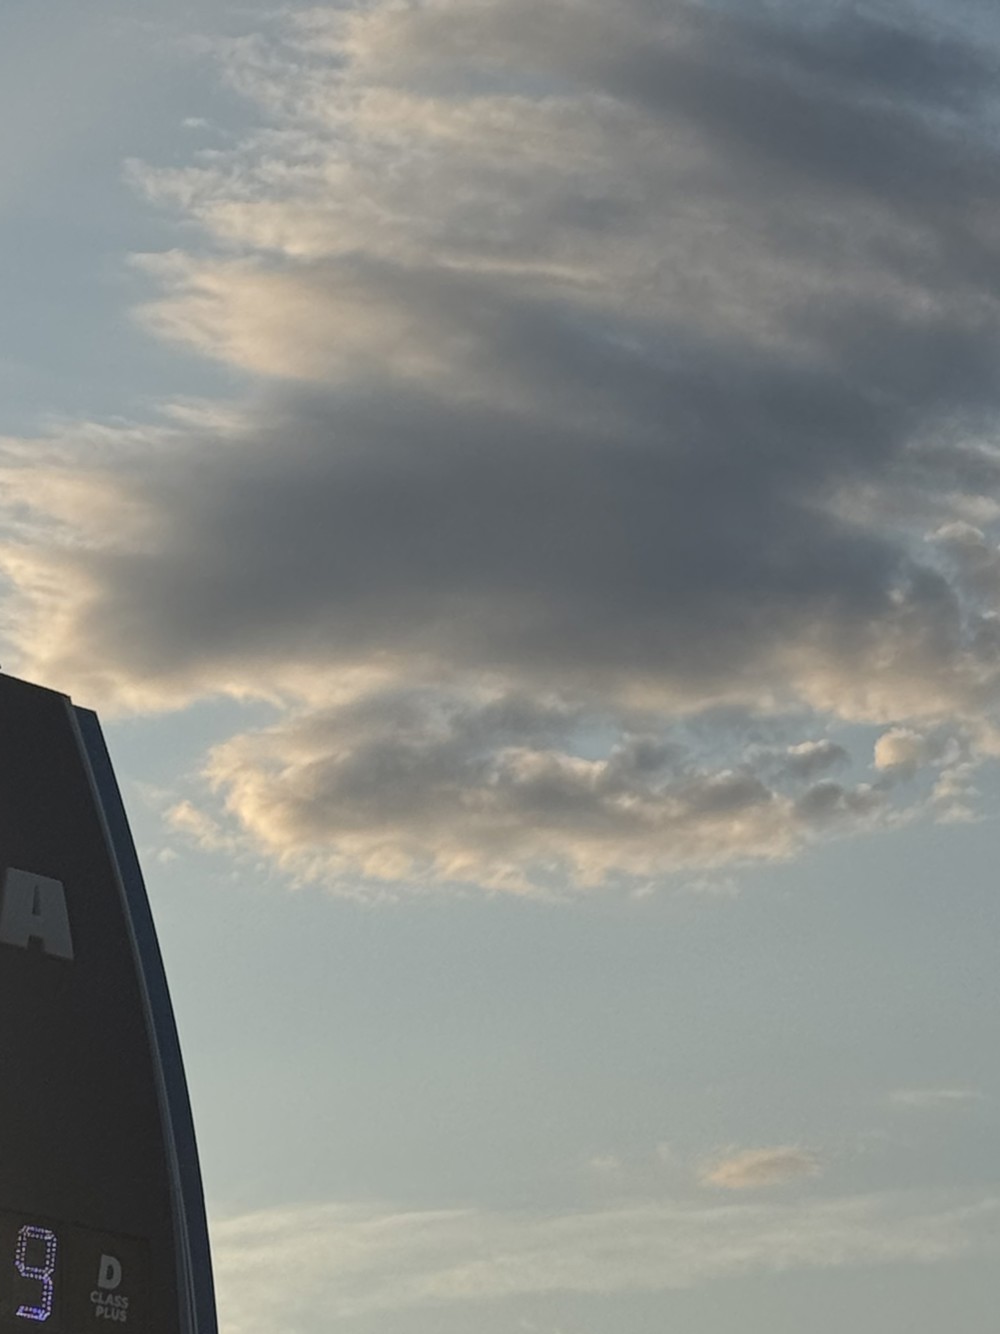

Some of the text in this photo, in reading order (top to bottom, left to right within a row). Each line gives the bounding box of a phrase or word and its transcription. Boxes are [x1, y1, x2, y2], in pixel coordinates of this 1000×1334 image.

[98, 1254, 122, 1290] D
[90, 1290, 128, 1310] CLASS
[95, 1306, 127, 1323] PLUS
